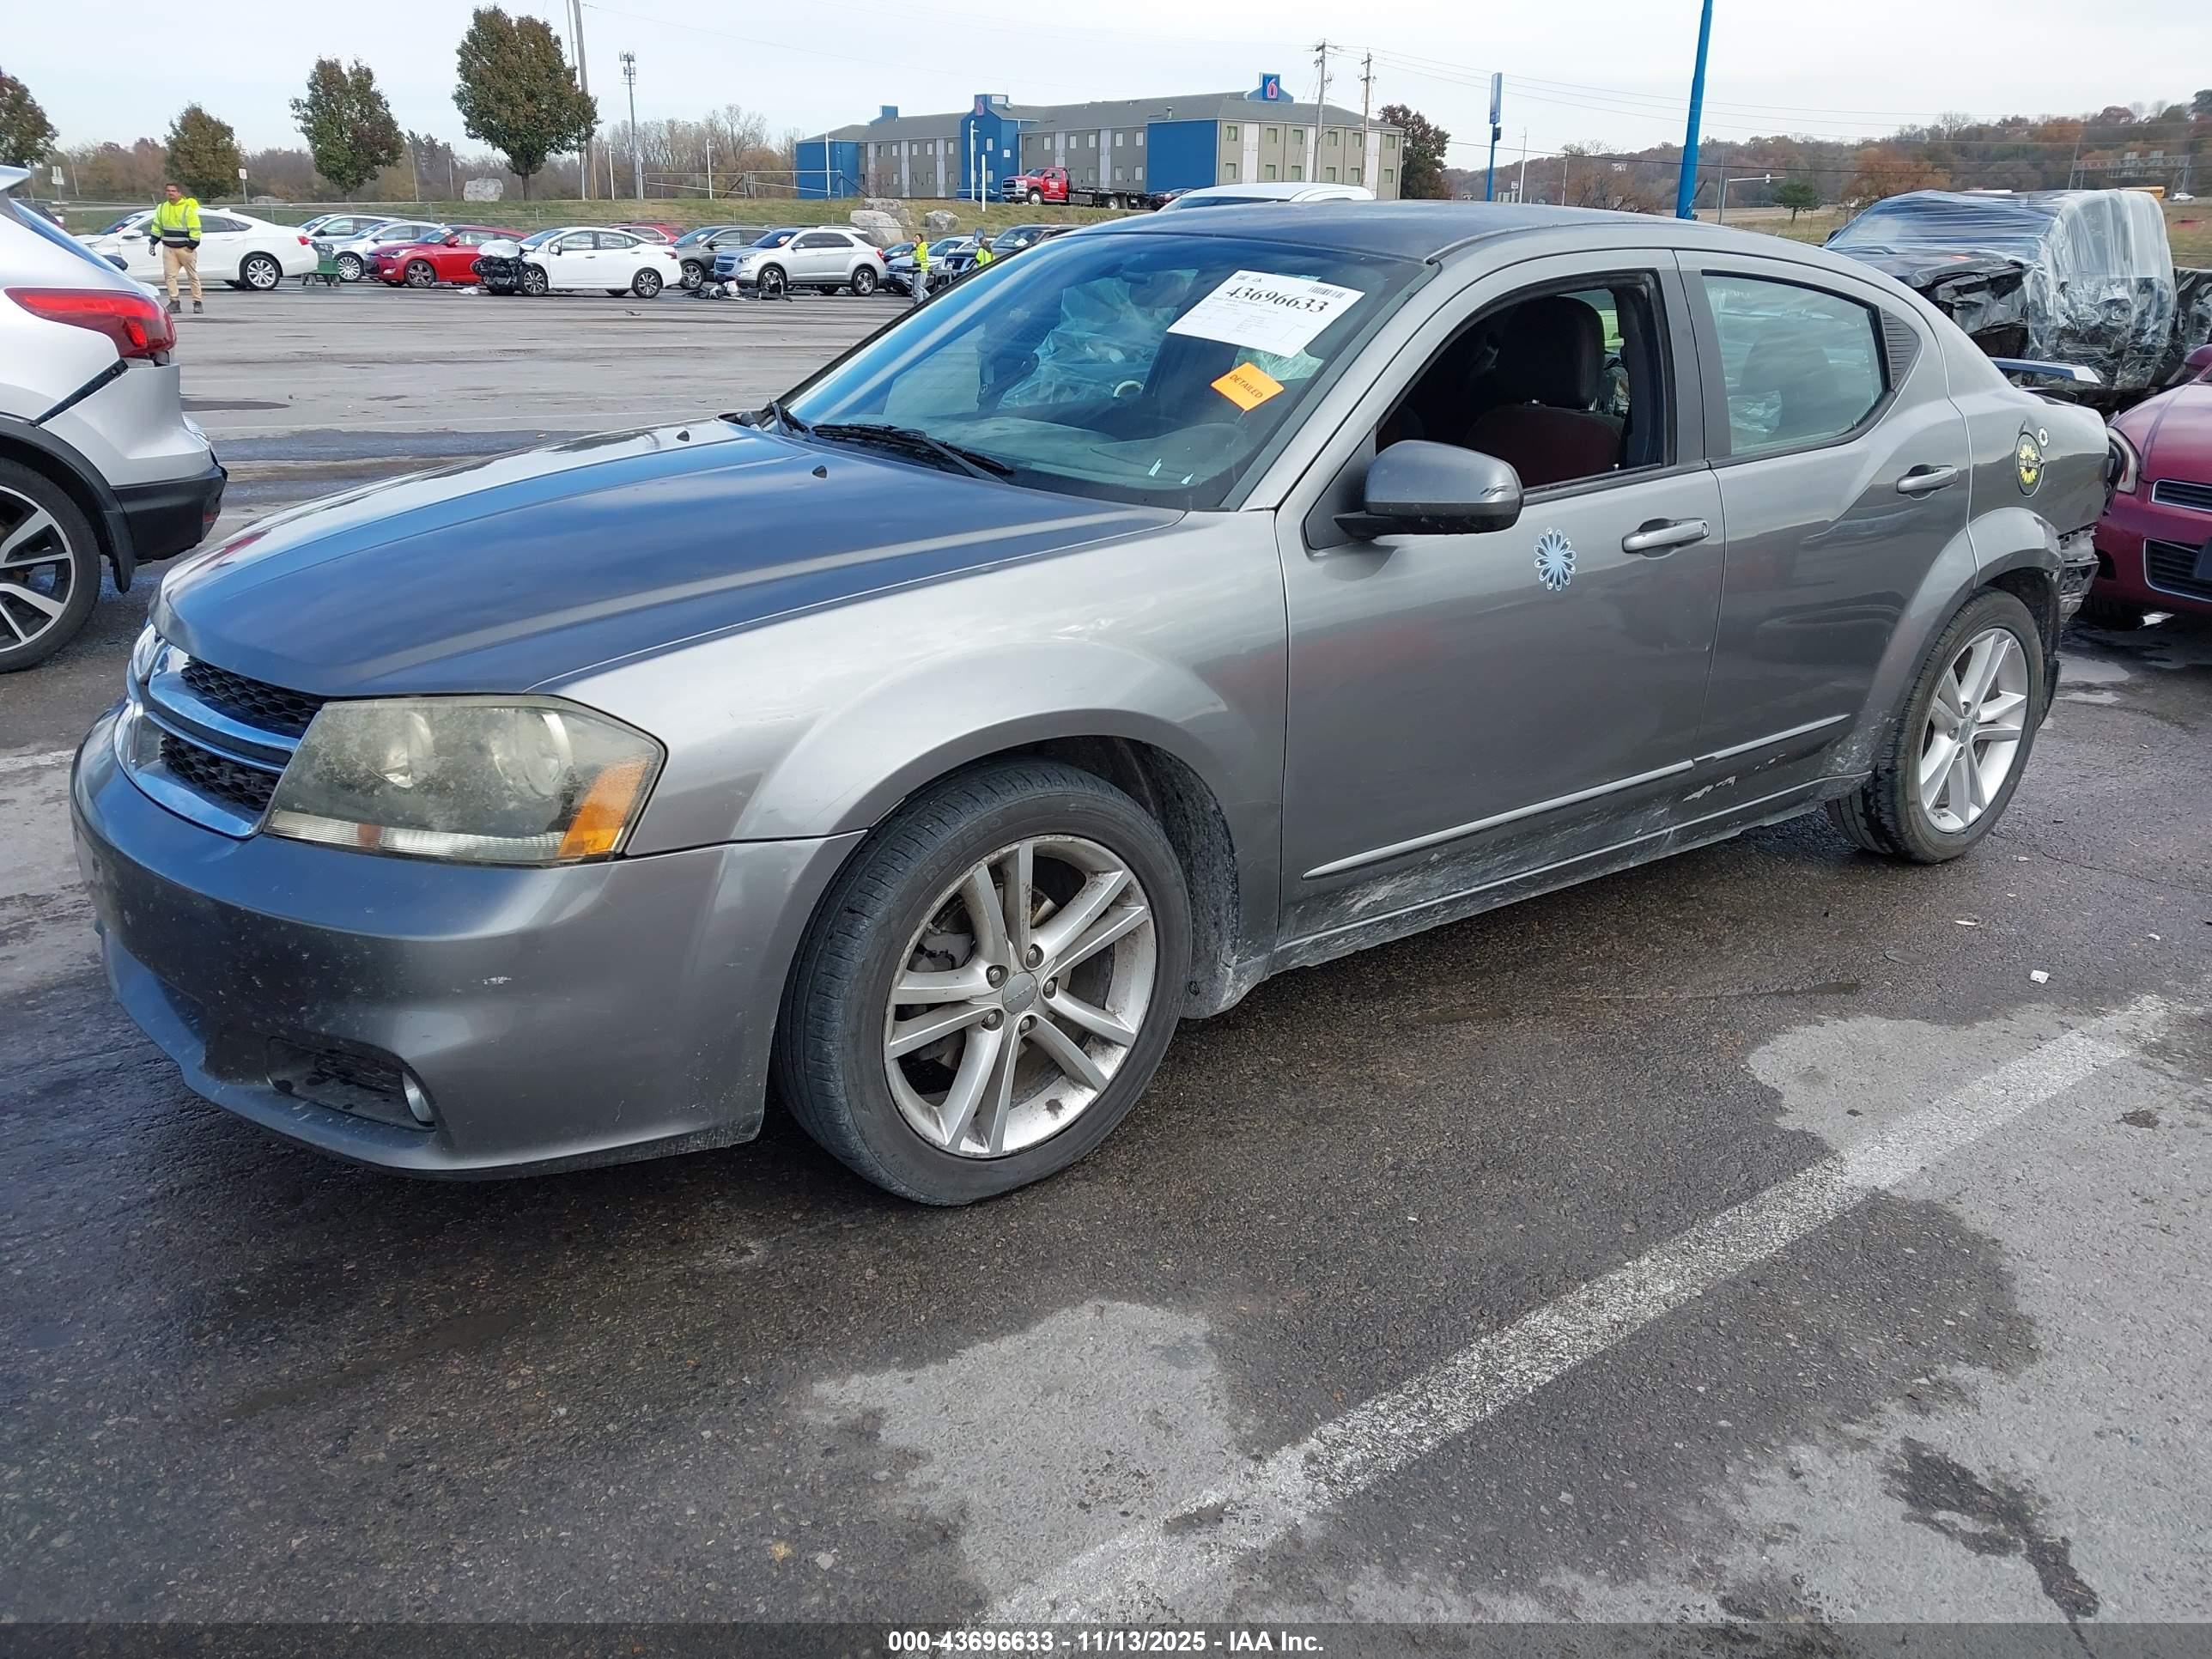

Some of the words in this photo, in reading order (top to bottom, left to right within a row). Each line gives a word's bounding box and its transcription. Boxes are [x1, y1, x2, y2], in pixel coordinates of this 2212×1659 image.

[1267, 77, 1279, 100] 6
[1226, 285, 1329, 313] 43696633
[1229, 374, 1264, 399] DETAILED
